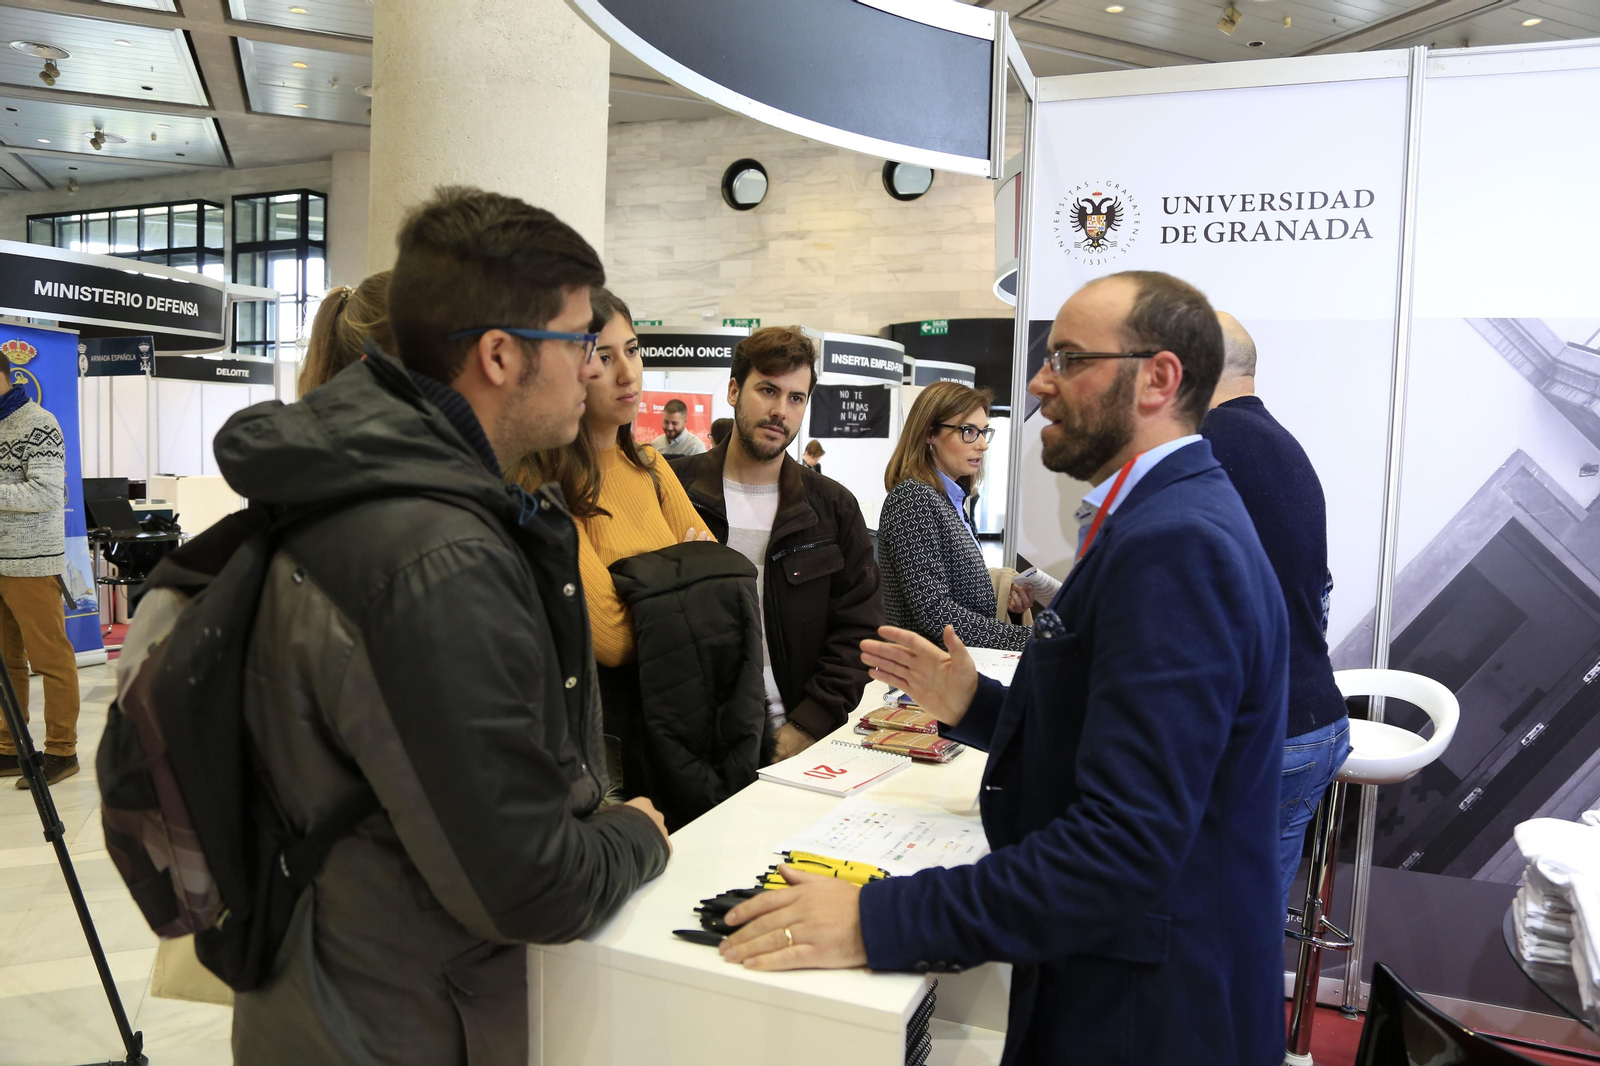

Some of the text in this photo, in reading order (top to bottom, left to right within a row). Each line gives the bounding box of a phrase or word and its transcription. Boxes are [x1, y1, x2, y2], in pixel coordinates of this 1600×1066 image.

[1161, 188, 1376, 216] UNIVERSIDAD
[1160, 216, 1374, 245] DE GRANADA
[34, 279, 199, 317] MINISTERIO DEFENSA
[639, 344, 732, 358] NDACIÓN ONCE
[91, 353, 137, 362] ARMADA ESPAÑOLA
[831, 353, 870, 368] INSERTA
[216, 367, 250, 378] DELOITTE
[839, 390, 863, 400] NO TE
[842, 401, 869, 412] RINDAS
[840, 411, 867, 421] NUNCA
